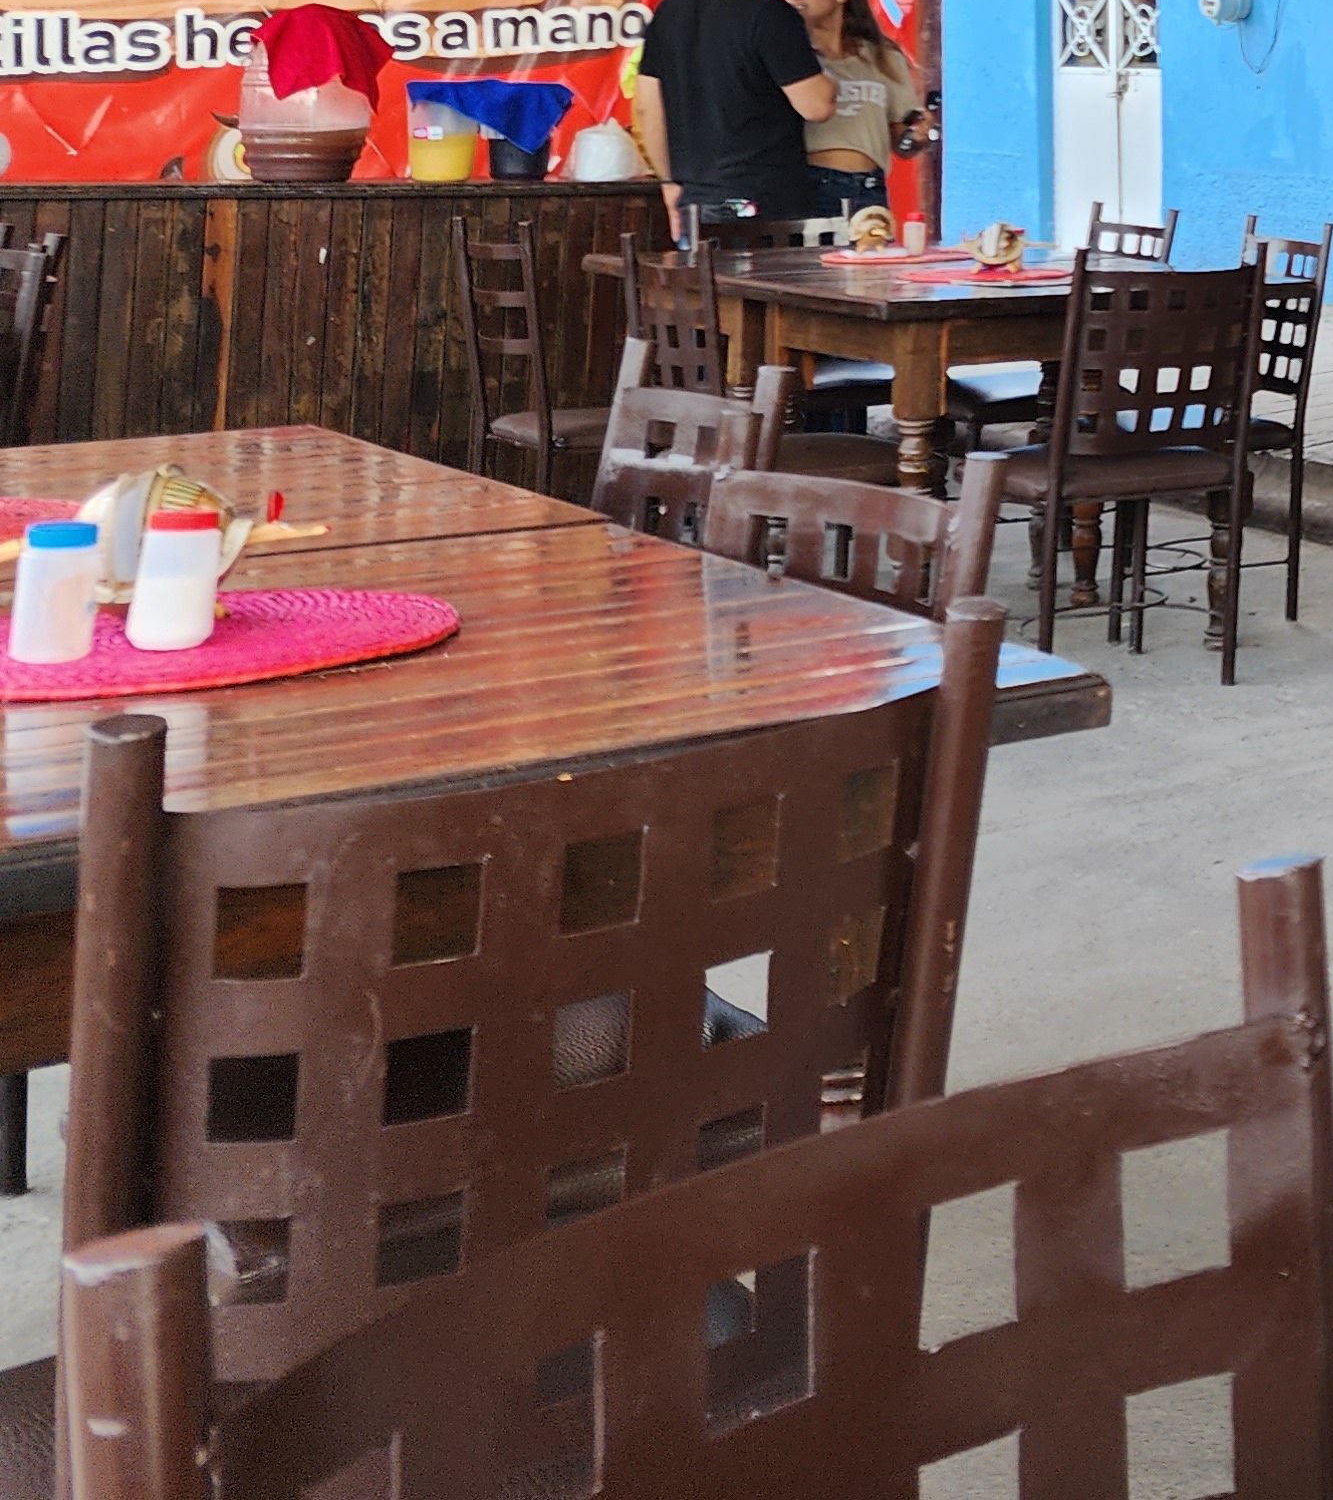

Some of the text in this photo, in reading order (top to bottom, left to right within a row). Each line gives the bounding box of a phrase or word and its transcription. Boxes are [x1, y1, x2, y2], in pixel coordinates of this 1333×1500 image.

[0, 17, 161, 67] illas
[443, 18, 471, 49] a
[492, 10, 646, 49] mano
